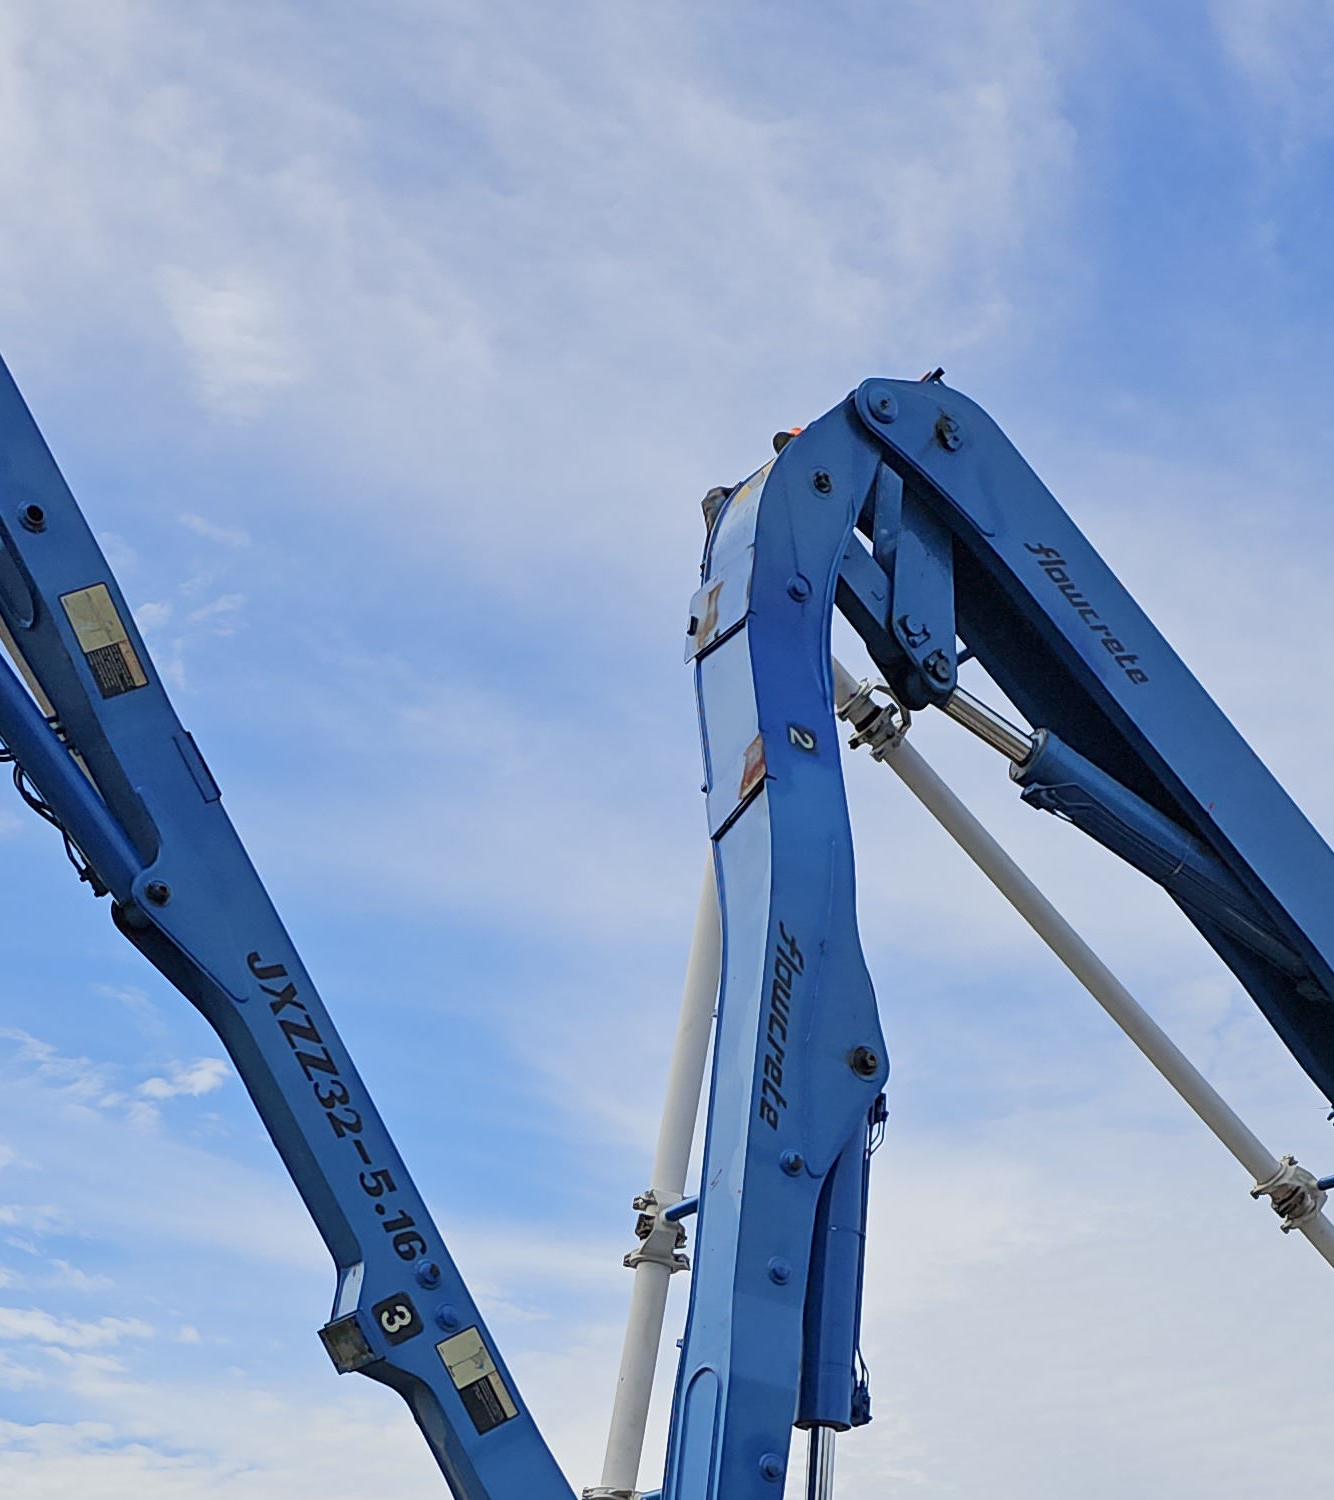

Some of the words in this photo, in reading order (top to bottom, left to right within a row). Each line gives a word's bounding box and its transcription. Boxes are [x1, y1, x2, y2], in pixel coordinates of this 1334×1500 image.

[1023, 542, 1150, 685] flowcrete
[789, 726, 814, 749] 2
[759, 920, 805, 1132] flowcrete
[246, 951, 428, 1262] JXZZ32-5.16
[381, 1305, 412, 1333] 3
